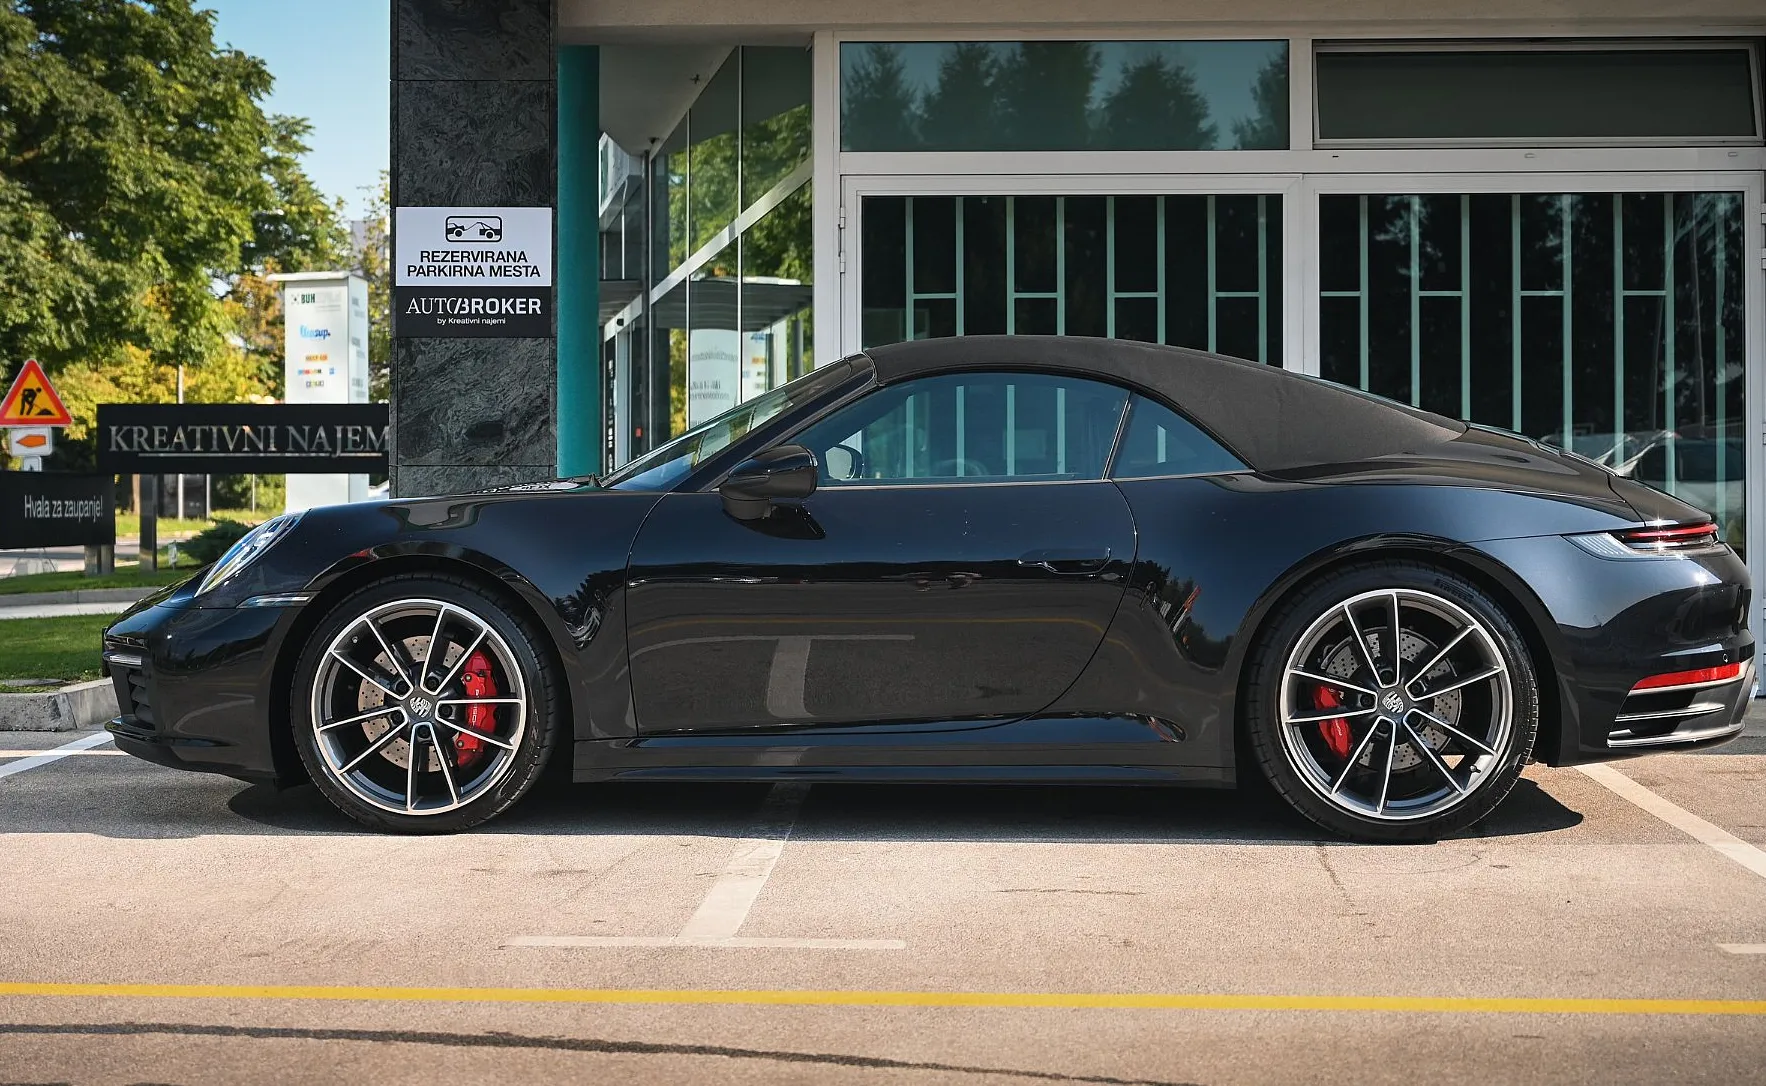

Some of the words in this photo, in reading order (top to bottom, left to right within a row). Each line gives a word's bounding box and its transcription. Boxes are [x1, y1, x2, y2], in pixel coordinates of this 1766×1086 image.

[420, 250, 528, 263] REZERVIRANA
[407, 265, 485, 277] PARKIRNA
[489, 265, 541, 277] MESTA
[437, 318, 446, 326] by
[448, 317, 480, 325] Kreativni
[481, 317, 506, 326] najemi
[108, 425, 277, 451] KREATIVNI
[24, 494, 50, 518] Hvala
[52, 499, 63, 518] za
[64, 495, 103, 523] zaupanje!
